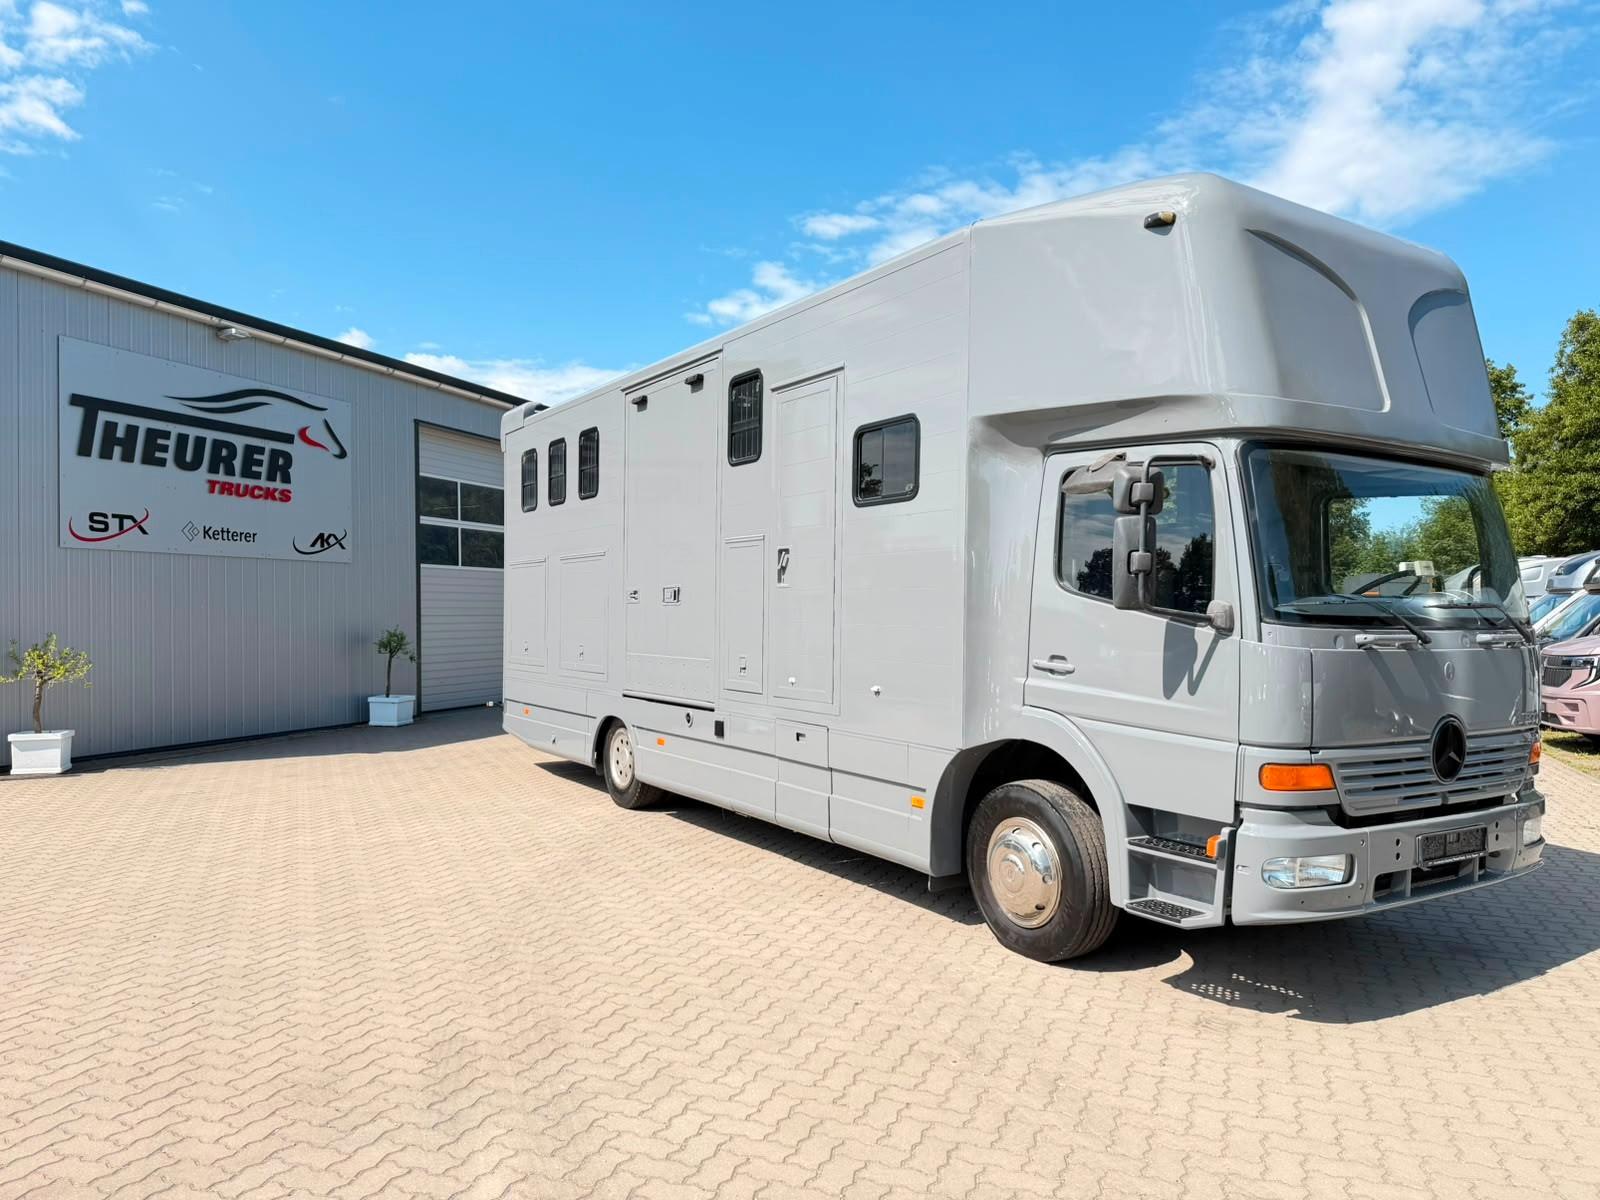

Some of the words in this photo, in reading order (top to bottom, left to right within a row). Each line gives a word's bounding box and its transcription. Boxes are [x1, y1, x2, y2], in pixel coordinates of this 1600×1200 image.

[69, 393, 295, 484] THEURER
[206, 479, 292, 502] TRUCKS
[88, 508, 149, 536] STX
[203, 526, 257, 543] Ketterer
